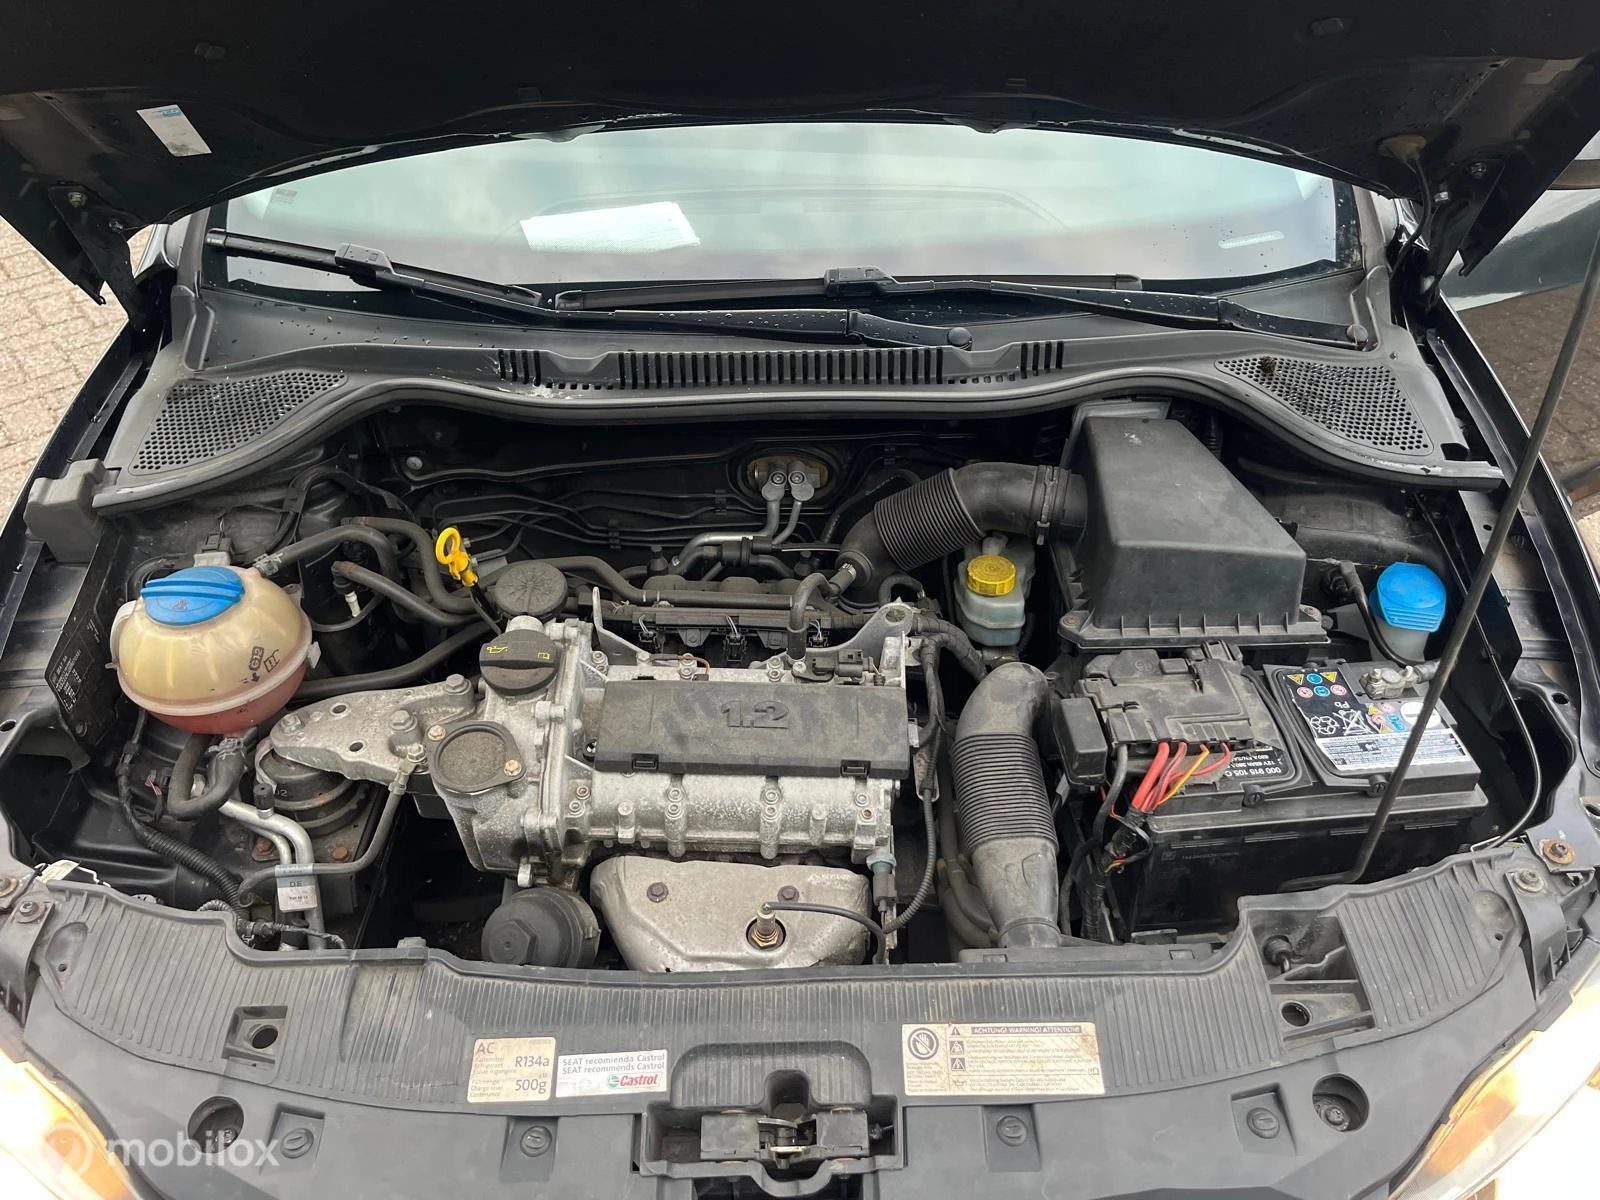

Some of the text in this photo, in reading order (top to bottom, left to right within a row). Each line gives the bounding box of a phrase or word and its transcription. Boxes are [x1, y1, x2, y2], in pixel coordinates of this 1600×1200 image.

[1334, 701, 1350, 709] Pb
[720, 700, 790, 729] 1.2
[289, 880, 303, 888] DE
[476, 1042, 495, 1055] AC
[515, 1055, 550, 1068] R134a
[562, 1053, 665, 1066] SEAT recomienda Castrol
[562, 1062, 665, 1075] SEAT recommends Castrol
[515, 1078, 547, 1094] 500g
[620, 1074, 658, 1087] Castrol
